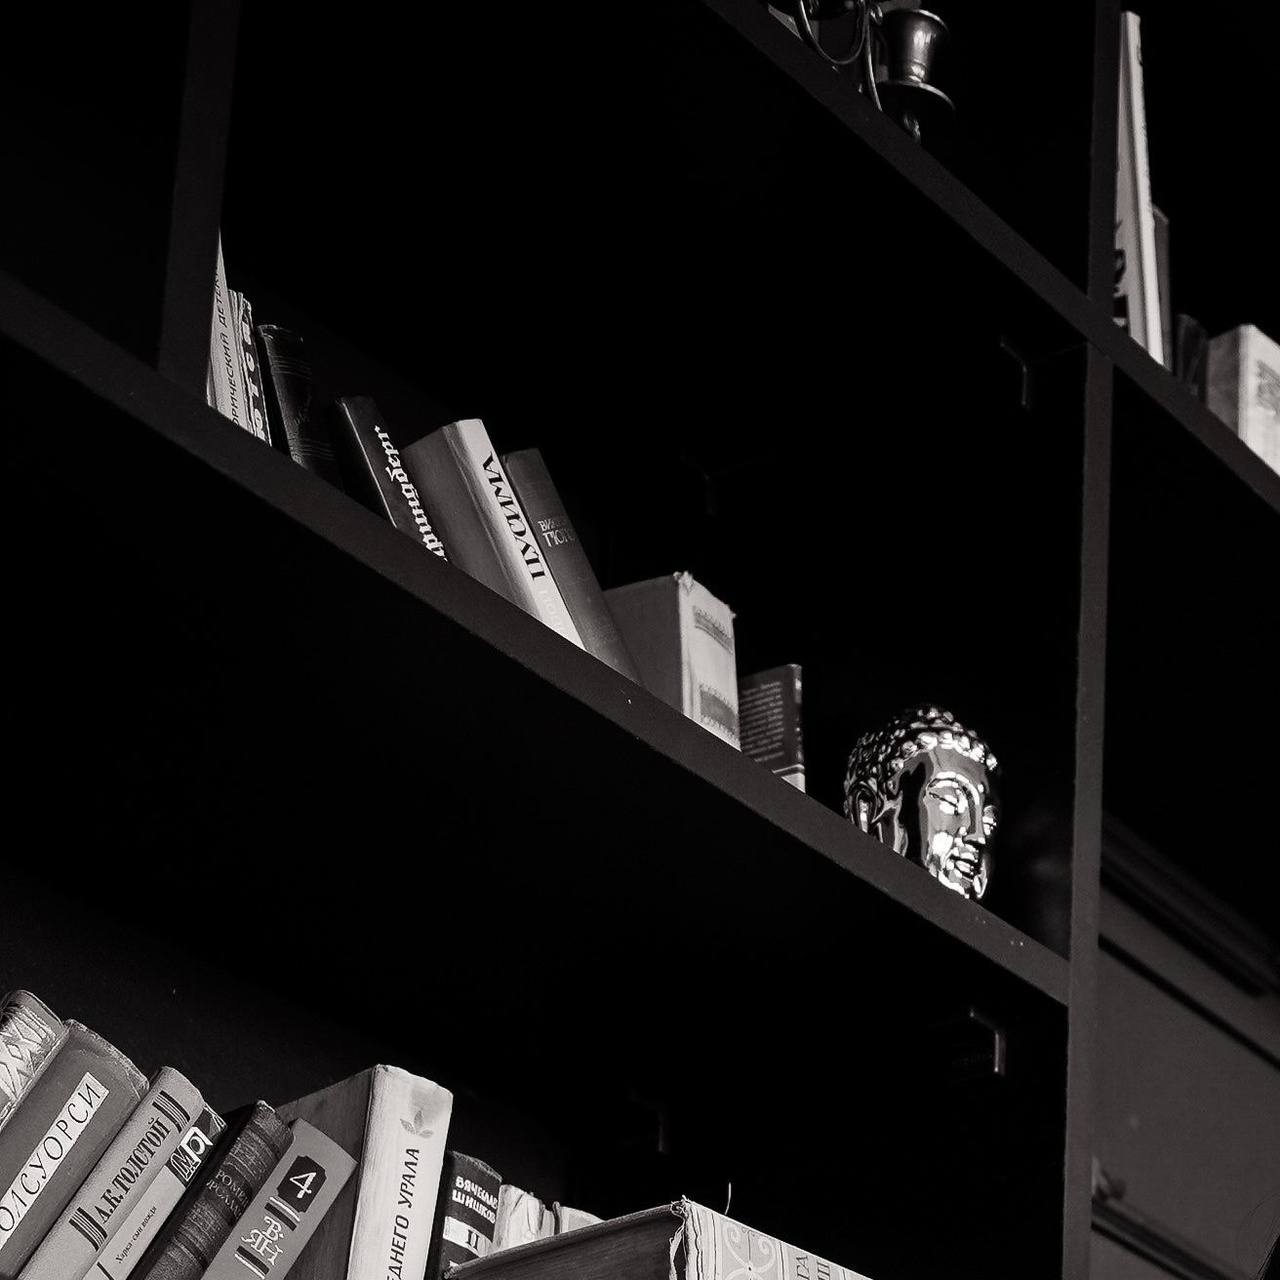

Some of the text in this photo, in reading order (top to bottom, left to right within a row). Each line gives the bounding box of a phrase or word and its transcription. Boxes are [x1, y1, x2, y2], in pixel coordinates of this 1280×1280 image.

[220, 333, 239, 428] ОРИЧЕСКИЙ
[481, 453, 545, 580] ЦУСИМА
[0, 1084, 104, 1235] ОЛСУОРСИ
[288, 1171, 316, 1199] 4
[402, 1147, 421, 1210] УРАЛА
[451, 1190, 497, 1226] ШИШКОВ
